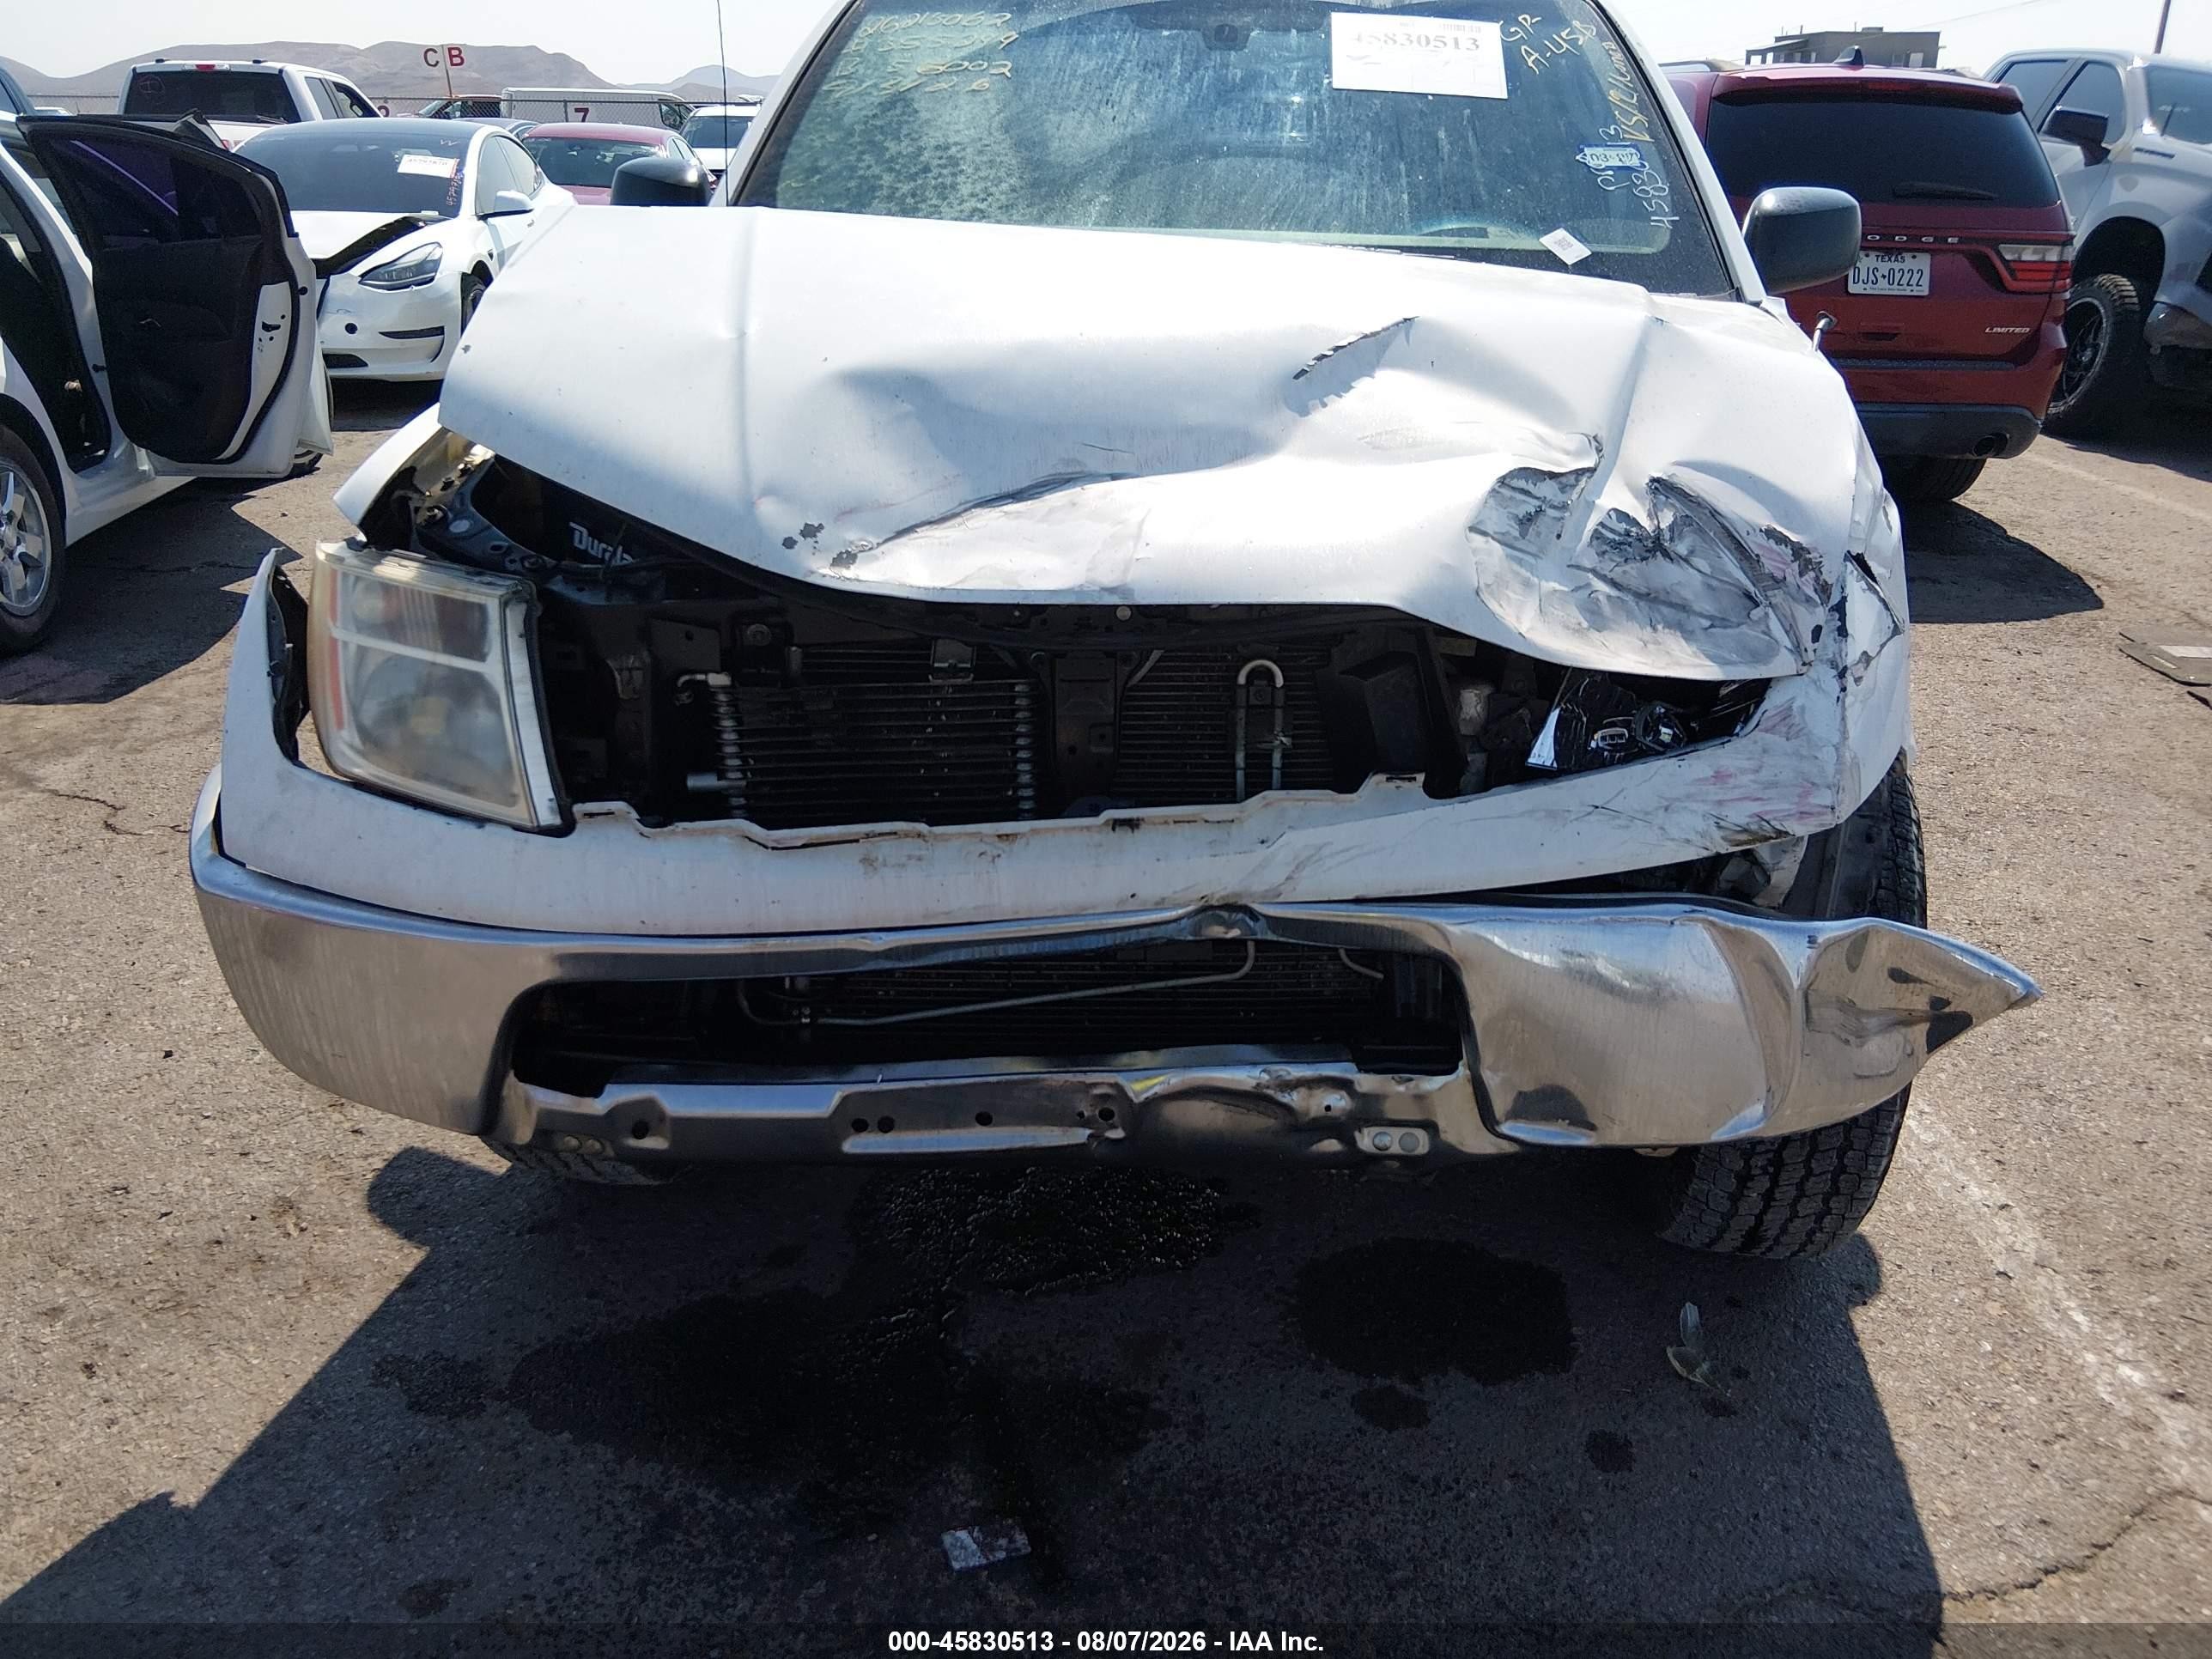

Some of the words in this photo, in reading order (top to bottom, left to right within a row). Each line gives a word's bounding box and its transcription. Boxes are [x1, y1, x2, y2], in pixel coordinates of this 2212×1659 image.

[423, 48, 440, 68] C
[447, 46, 465, 67] B
[574, 106, 590, 123] 7
[1867, 234, 1960, 244] ODGE
[1875, 254, 1906, 264] TEXAS
